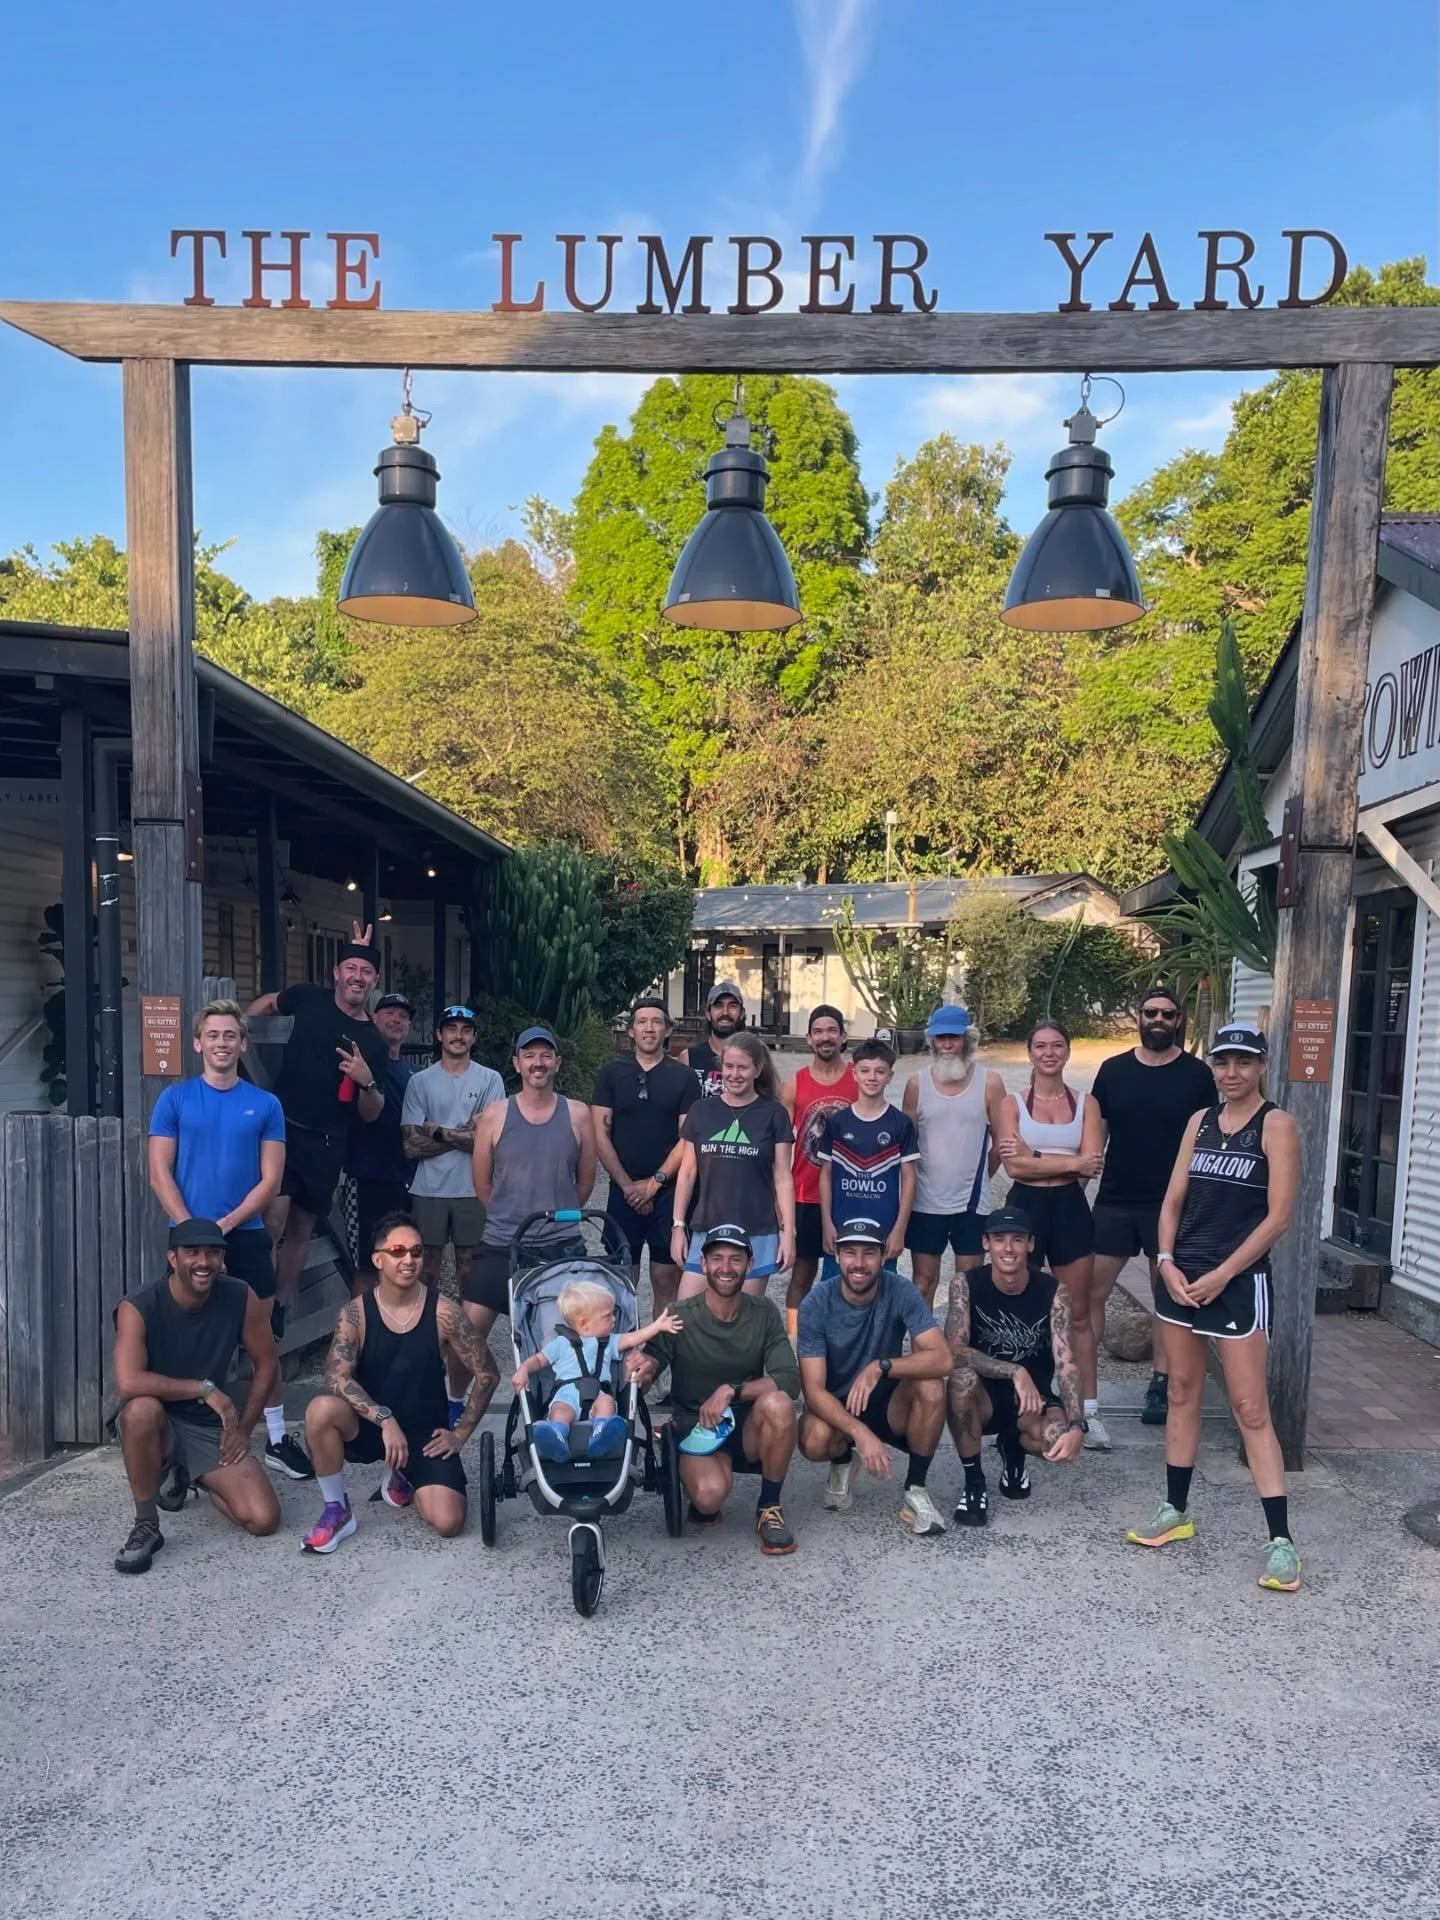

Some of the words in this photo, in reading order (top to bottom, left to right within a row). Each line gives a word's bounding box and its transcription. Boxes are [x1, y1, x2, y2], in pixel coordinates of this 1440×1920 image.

[170, 229, 381, 310] THE
[491, 232, 938, 314] LUMBER
[1043, 229, 1349, 312] YARD
[1297, 1022, 1306, 1030] NO
[1307, 1022, 1329, 1030] ENTRY
[1298, 1037, 1325, 1045] VISITORS
[1303, 1045, 1320, 1053] CARS
[1302, 1053, 1318, 1061] ONLY
[701, 1143, 717, 1153] RUN
[720, 1144, 736, 1154] THE
[738, 1146, 759, 1157] HIGH
[841, 1178, 886, 1193] BOWLO
[846, 1191, 881, 1200] BANGALOW
